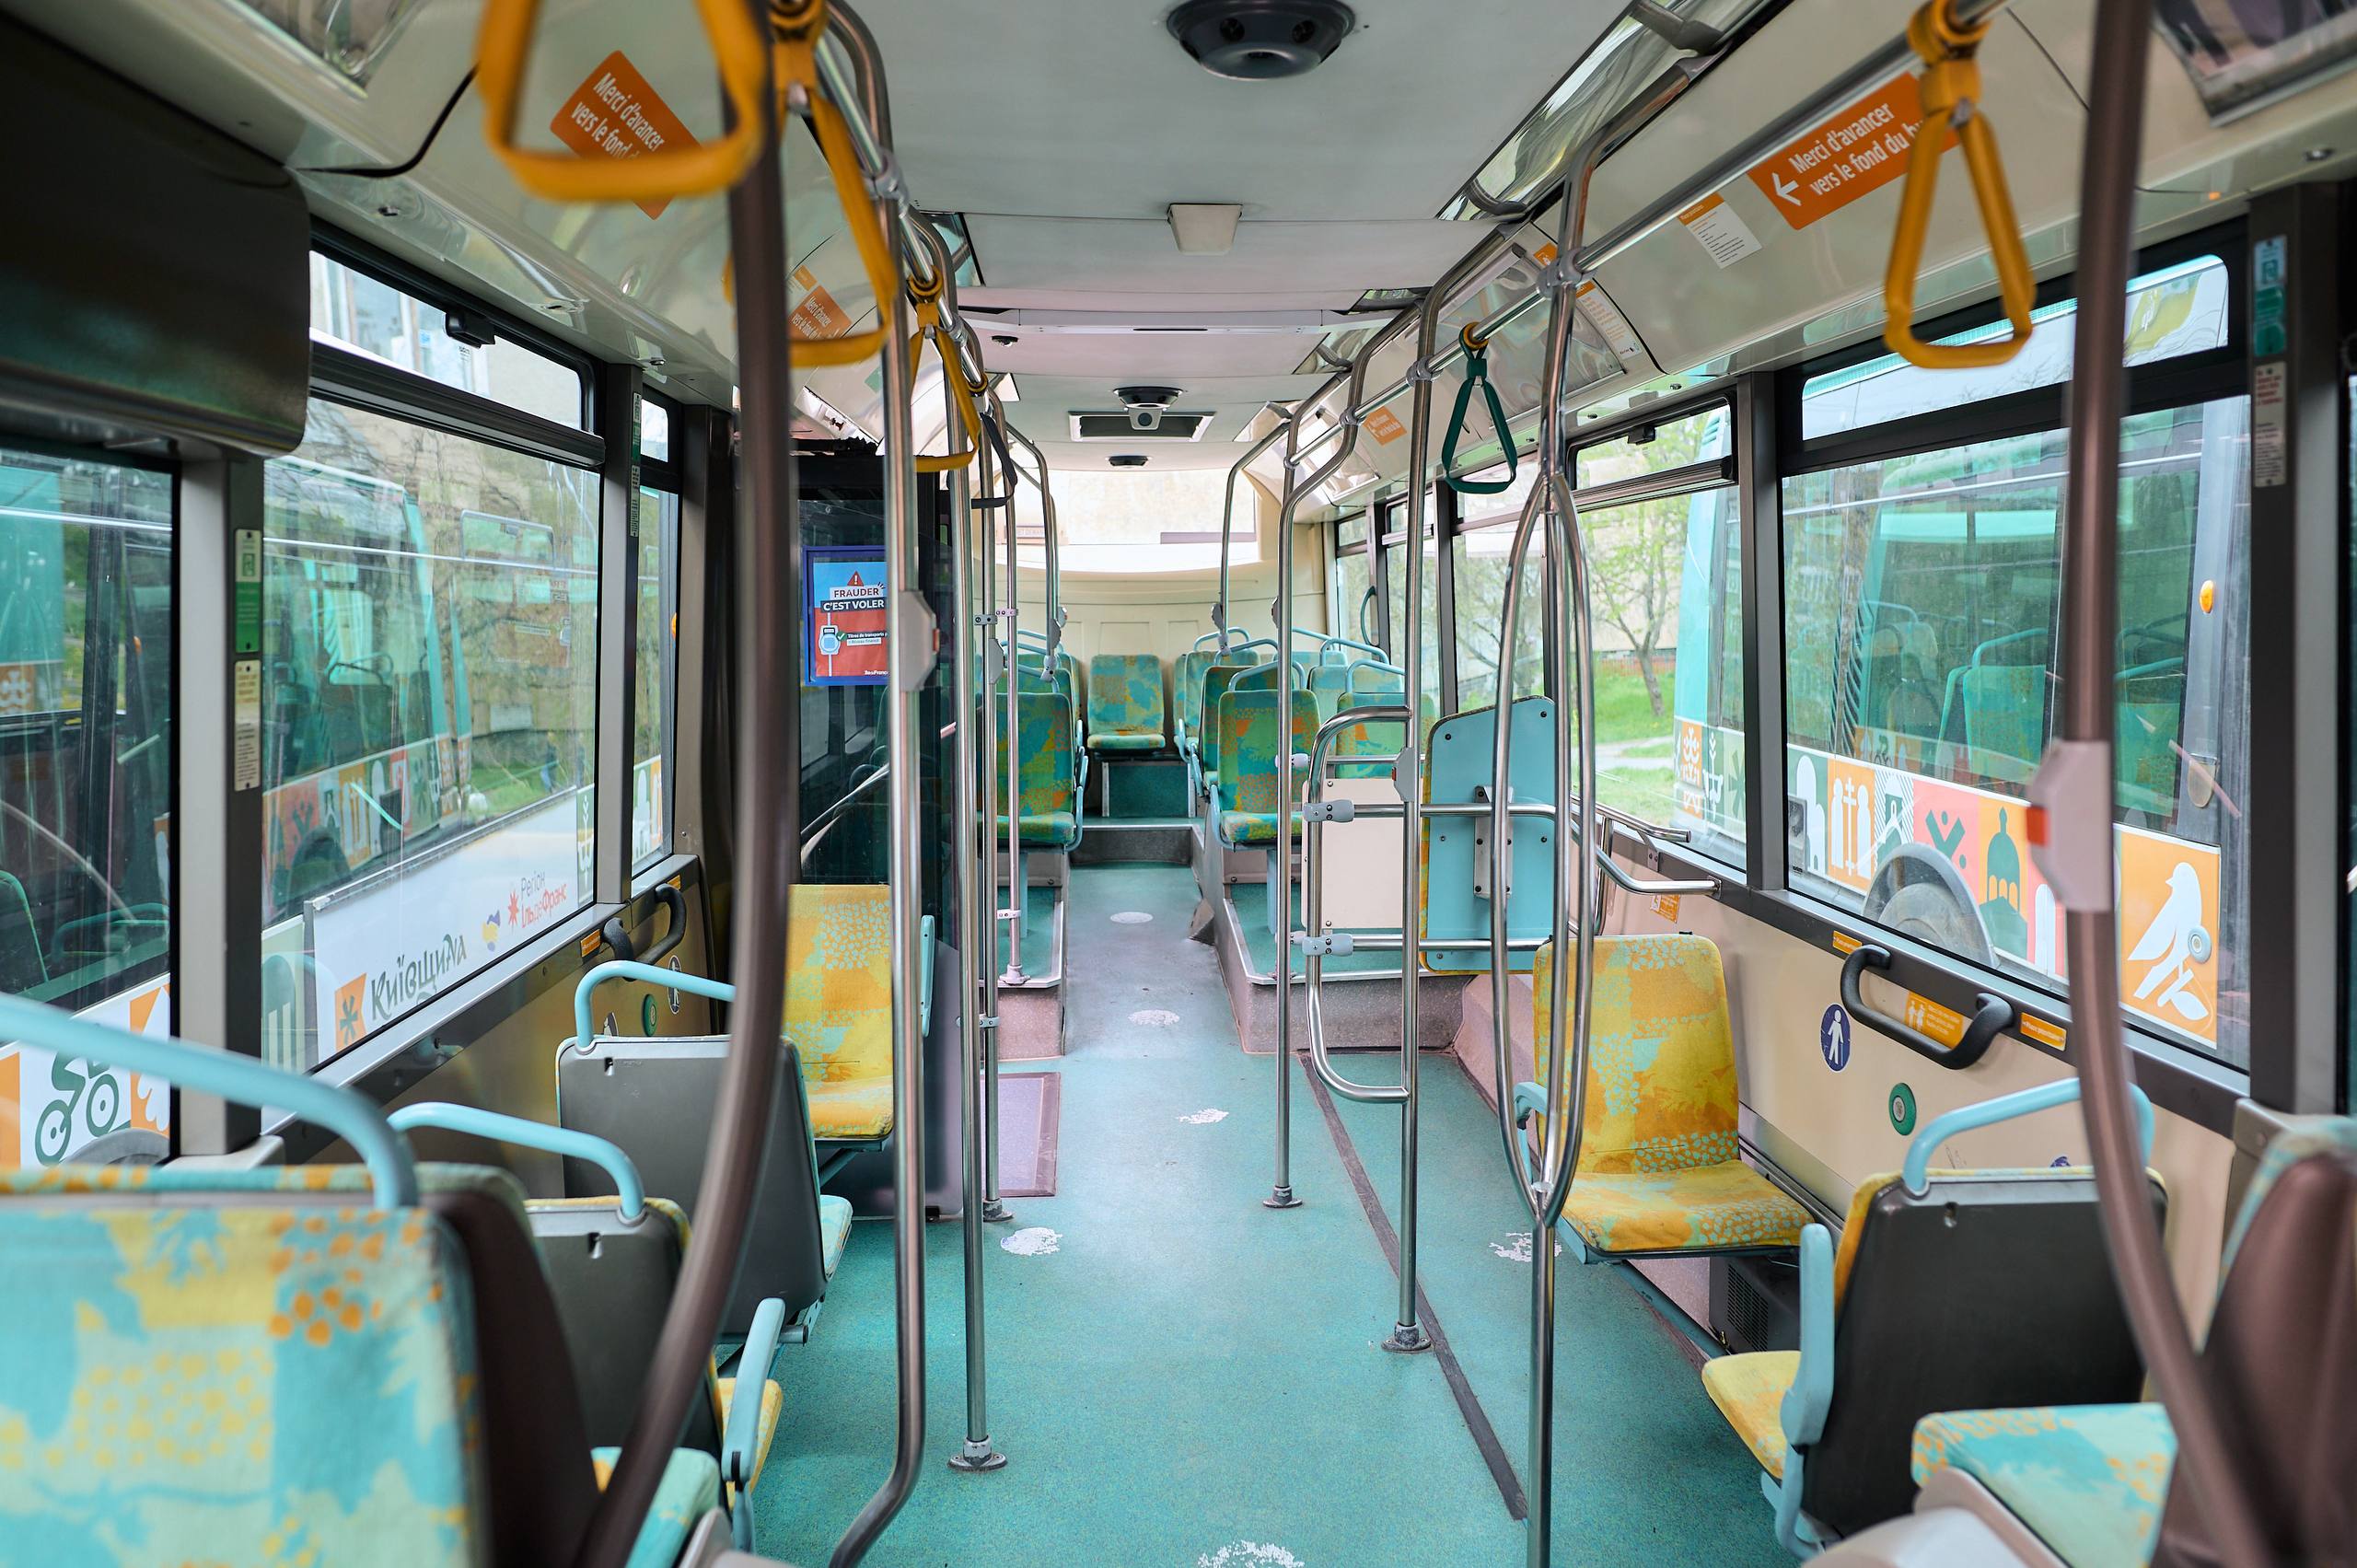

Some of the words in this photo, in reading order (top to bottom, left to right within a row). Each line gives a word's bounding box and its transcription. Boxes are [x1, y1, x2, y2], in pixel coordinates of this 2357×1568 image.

[571, 101, 598, 133] vers
[591, 118, 608, 142] le
[602, 129, 633, 159] fond
[593, 72, 632, 112] Merci
[620, 103, 665, 152] d'avancer
[1788, 140, 1831, 174] Merci
[1827, 103, 1895, 152] d'avancer
[1809, 172, 1841, 196] vers
[1833, 163, 1856, 181] le
[1848, 140, 1888, 173] fond
[1884, 133, 1910, 155] du
[823, 601, 851, 611] C'EST
[852, 599, 884, 609] VOLER
[834, 587, 879, 598] FRAUDER
